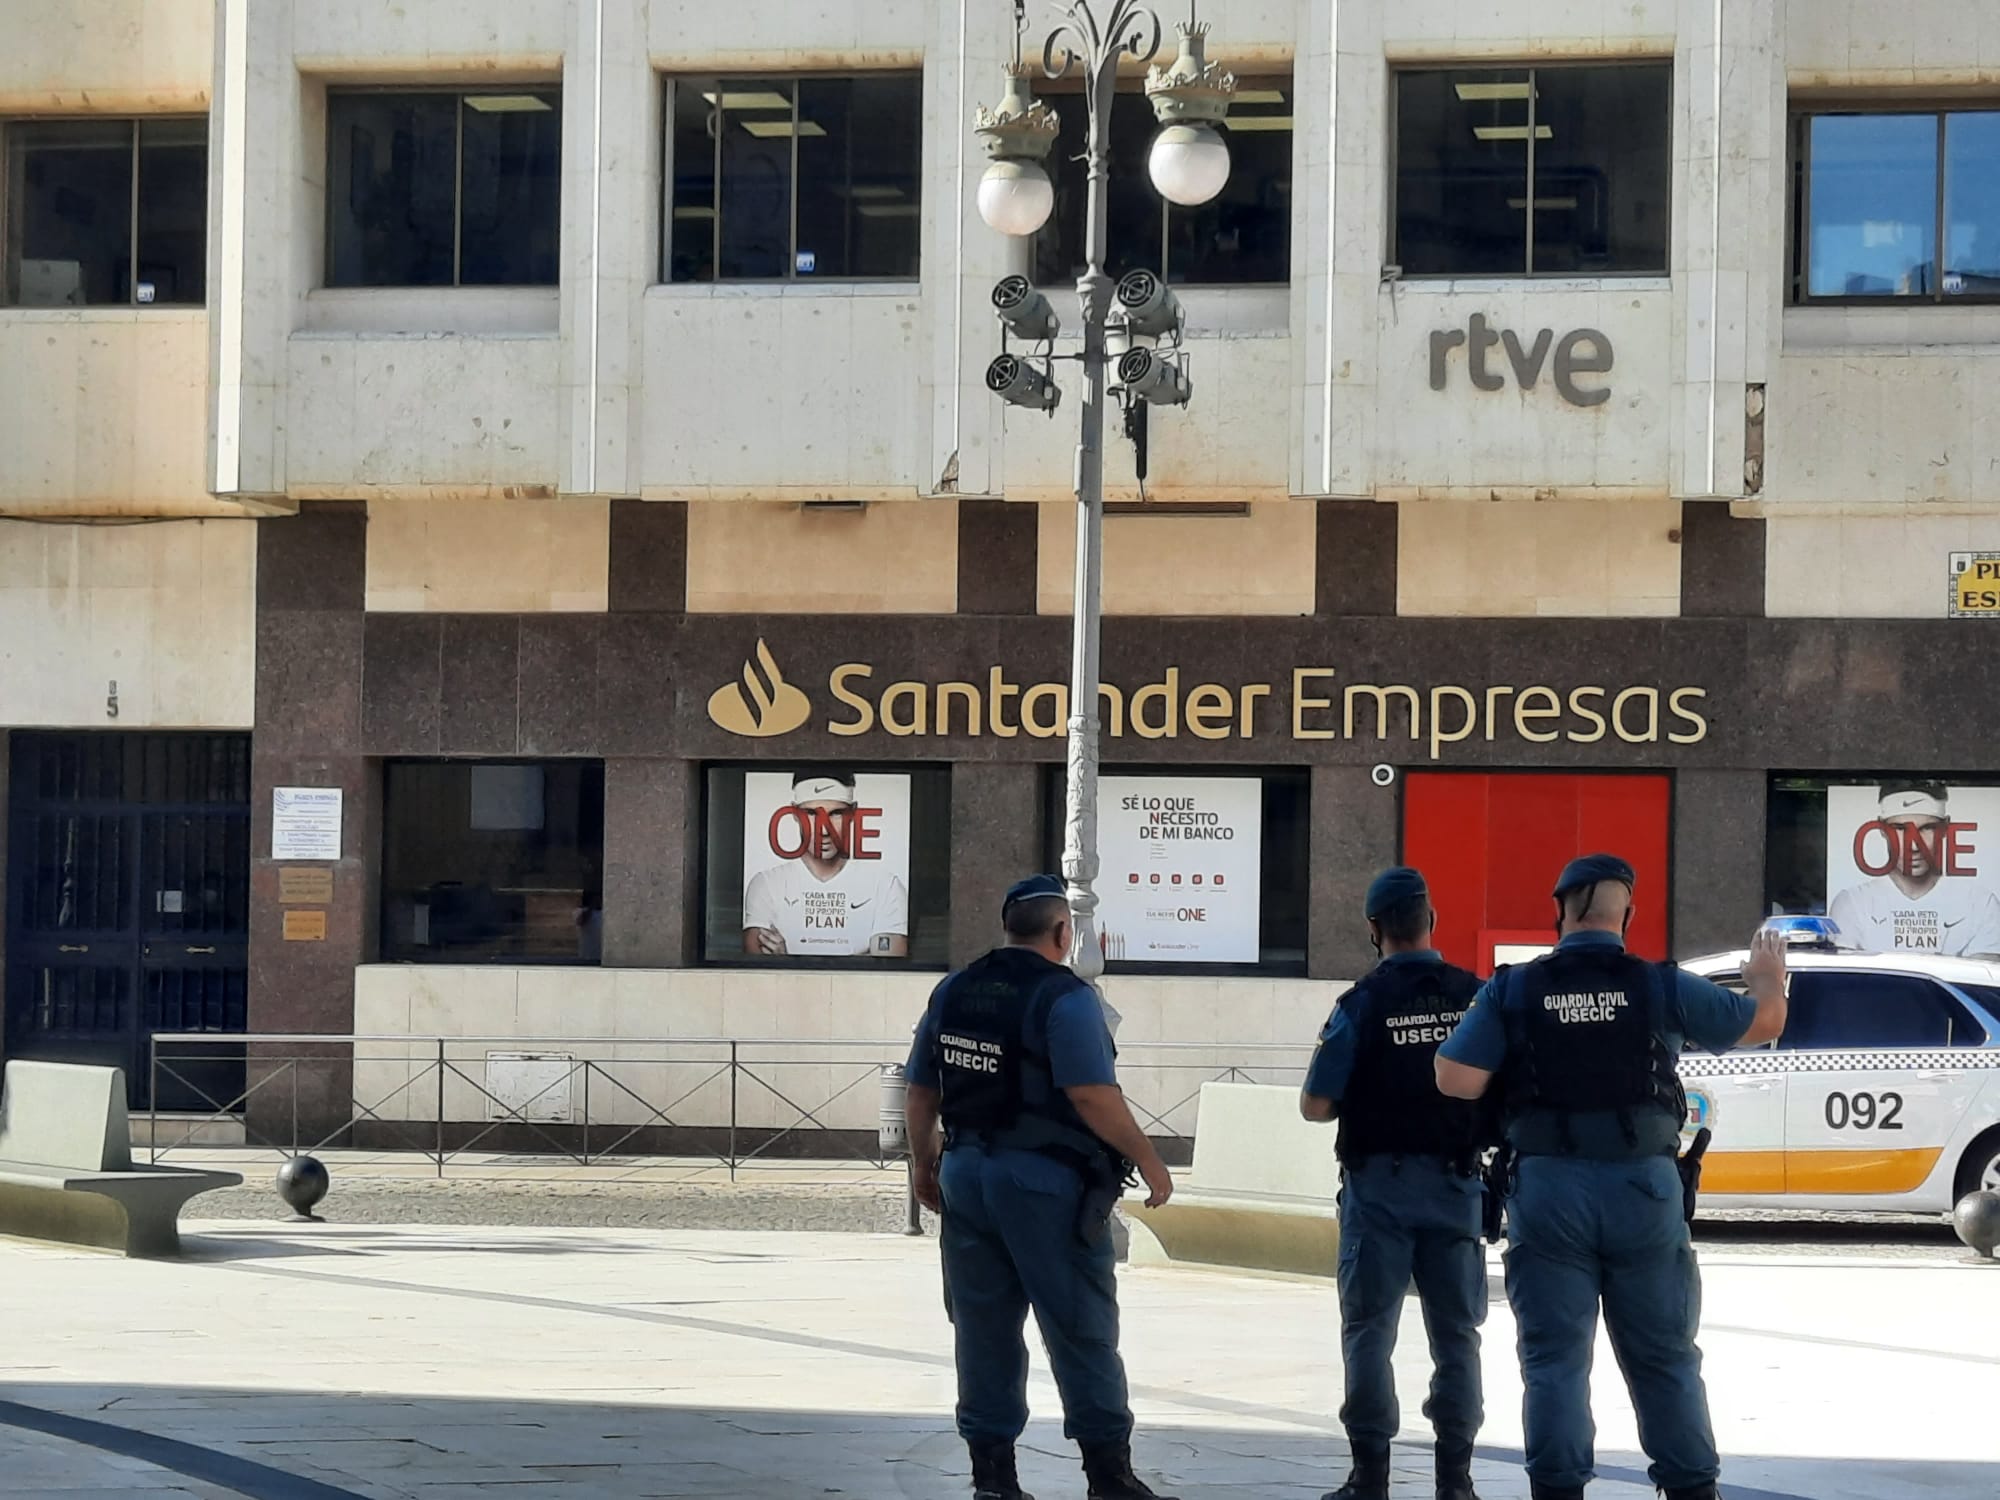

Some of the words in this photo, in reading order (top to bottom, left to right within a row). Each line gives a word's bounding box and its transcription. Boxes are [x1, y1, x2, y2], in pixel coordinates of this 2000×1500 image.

[1429, 312, 1614, 407] rtve
[1963, 591, 2000, 608] ES
[107, 696, 118, 718] 5
[828, 663, 1271, 739] Santander
[1291, 667, 1708, 760] Empresas
[1121, 794, 1139, 810] SÉ
[1143, 798, 1160, 810] LO
[1164, 798, 1195, 811] QUE
[1150, 812, 1219, 826] NECESITO
[768, 805, 883, 860] ONE
[1140, 827, 1159, 840] DE
[1162, 827, 1180, 840] MI
[1184, 827, 1234, 840] BANCO
[1853, 820, 1978, 877] ONE
[1177, 908, 1206, 922] ONE
[1544, 992, 1595, 1010] GUARDIA
[1598, 991, 1628, 1007] CIVIL
[1386, 1013, 1439, 1028] GUARDIA
[1440, 1010, 1466, 1022] CIVI
[1559, 1006, 1615, 1023] USECIC
[940, 1034, 978, 1050] GUARDIA
[980, 1042, 1003, 1056] CIVIL
[1393, 1026, 1456, 1045] USECI
[944, 1048, 998, 1073] USECIC
[1825, 1092, 1904, 1130] 092
